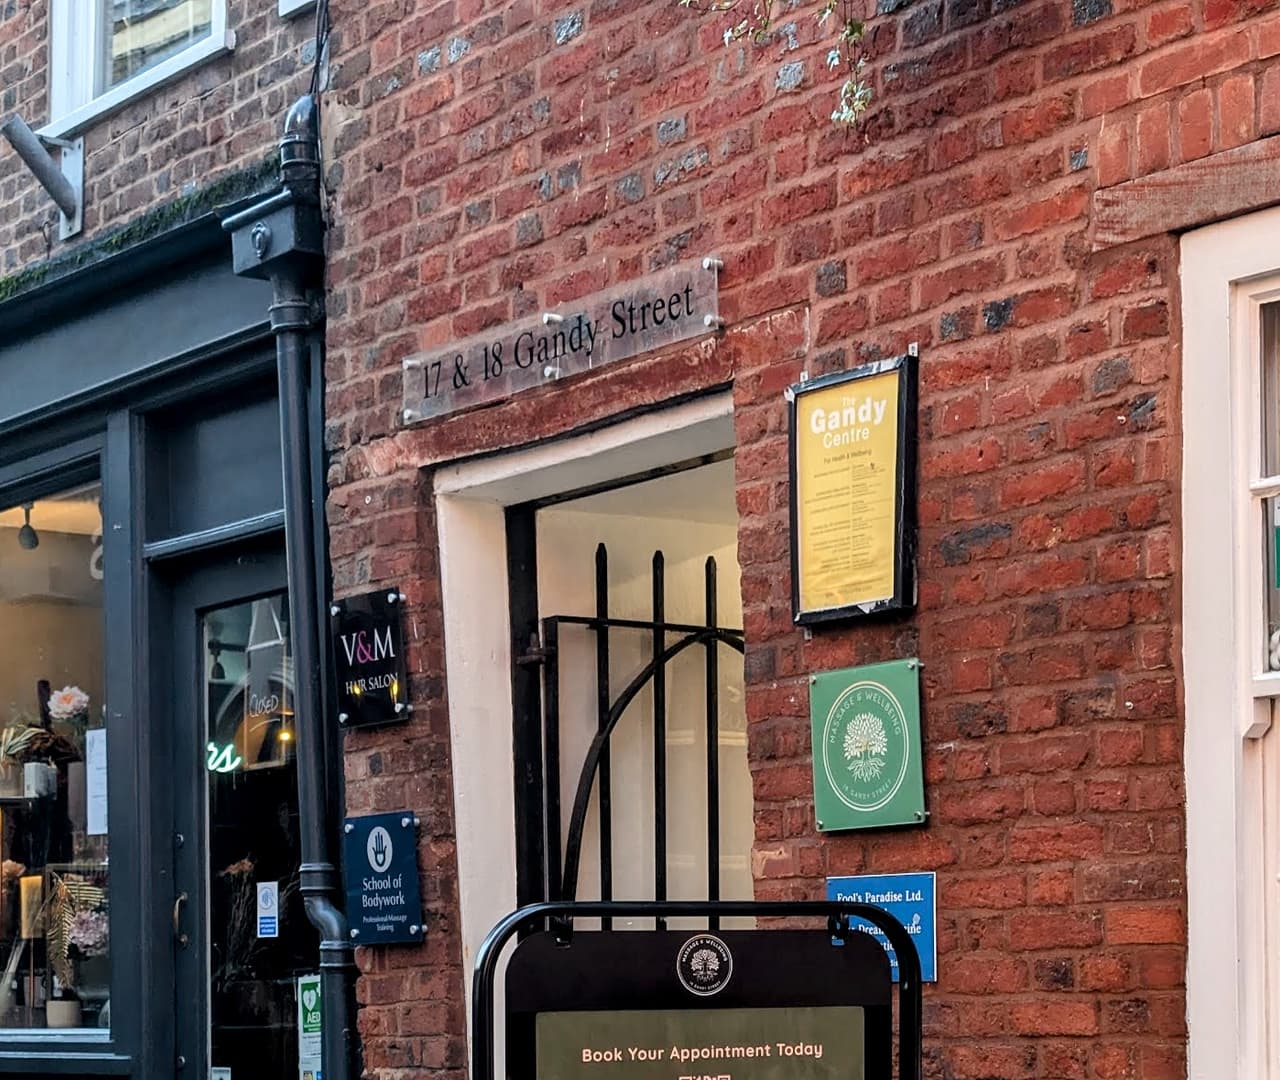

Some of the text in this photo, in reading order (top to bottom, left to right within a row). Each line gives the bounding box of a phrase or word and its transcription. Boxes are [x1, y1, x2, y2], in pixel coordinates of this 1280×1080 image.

[423, 281, 695, 399] 17 & 18 Gandy Street
[810, 396, 887, 435] Gandy
[822, 427, 870, 449] Centre
[340, 625, 396, 667] V&M
[368, 672, 399, 691] SALON
[830, 696, 855, 744] MASSAGE
[865, 690, 902, 736] WELLBEING
[362, 873, 402, 891] School of
[362, 890, 405, 910] Bodywork
[865, 890, 902, 903] Paradise
[905, 890, 924, 902] Ltd.
[581, 1042, 823, 1063] Book Your Appointment Today
